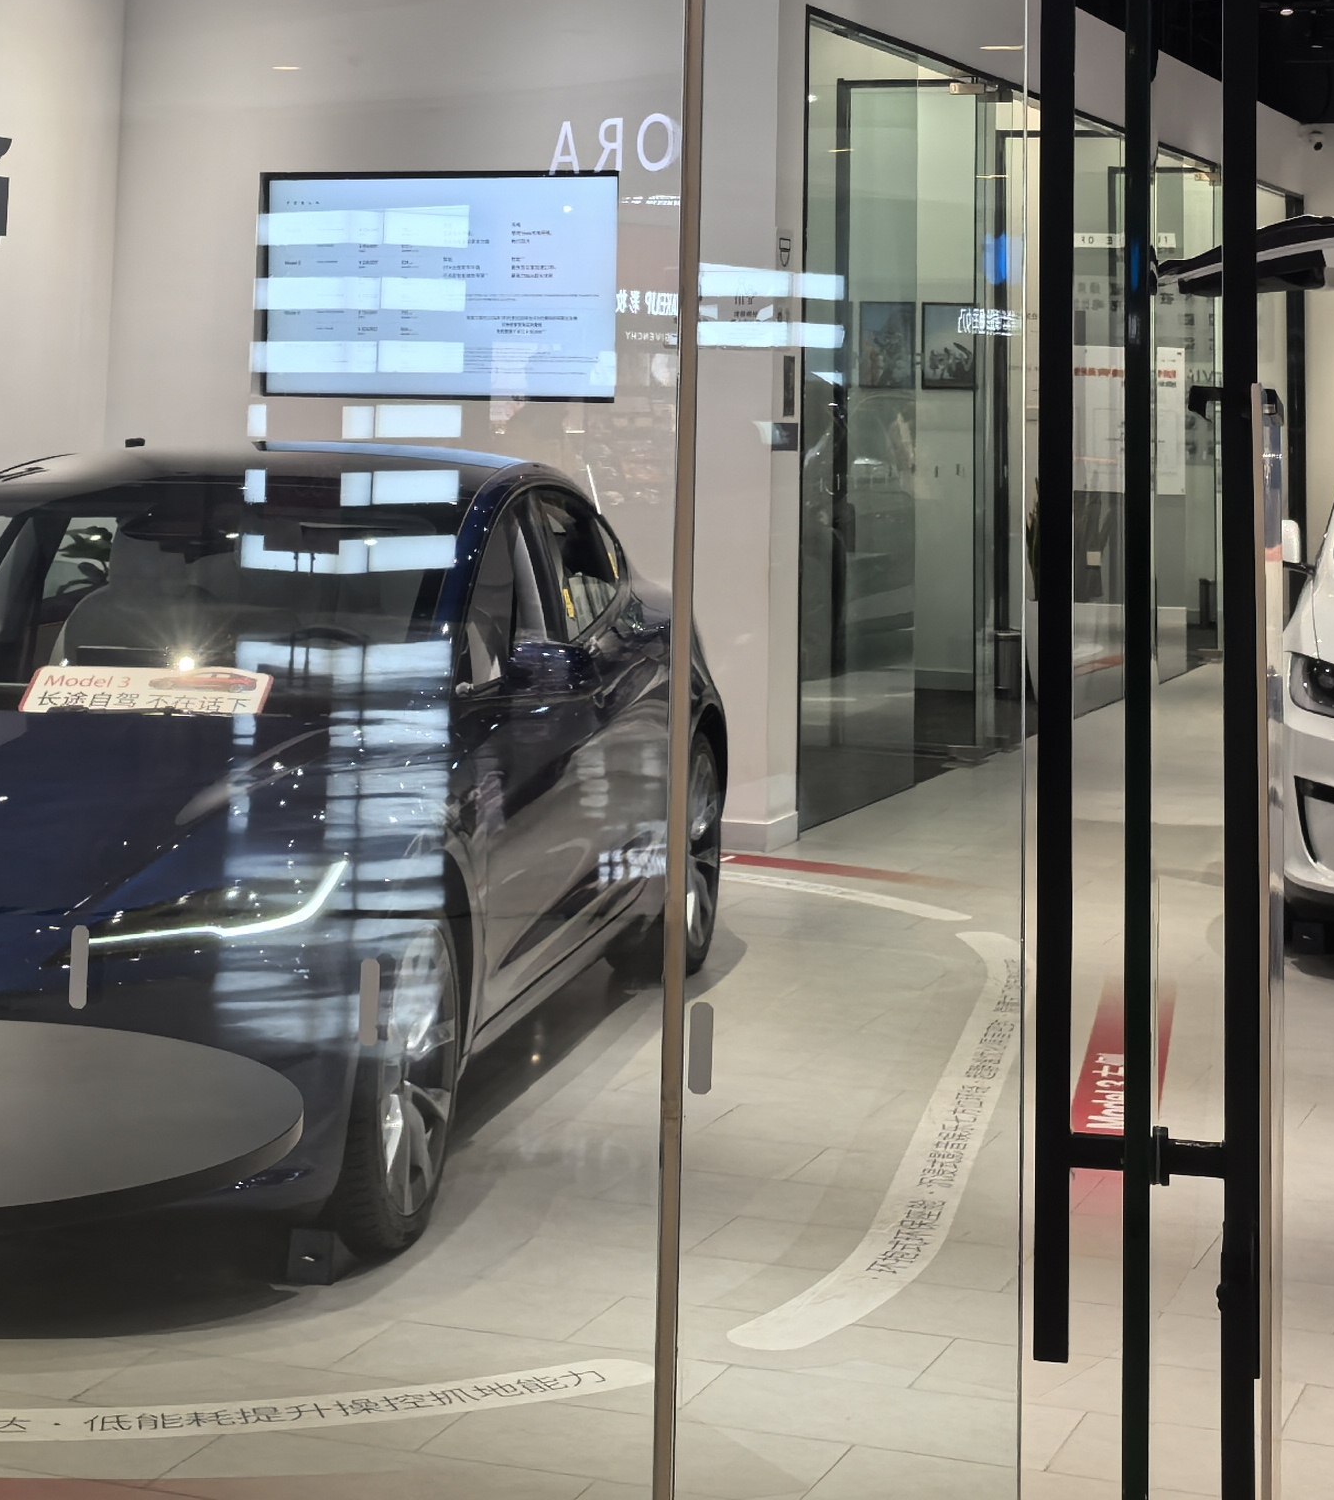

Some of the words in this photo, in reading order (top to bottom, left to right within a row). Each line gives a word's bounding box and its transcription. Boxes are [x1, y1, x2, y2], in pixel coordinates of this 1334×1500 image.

[43, 673, 114, 689] Model
[117, 675, 131, 689] 3
[36, 690, 140, 708] 长途自驾
